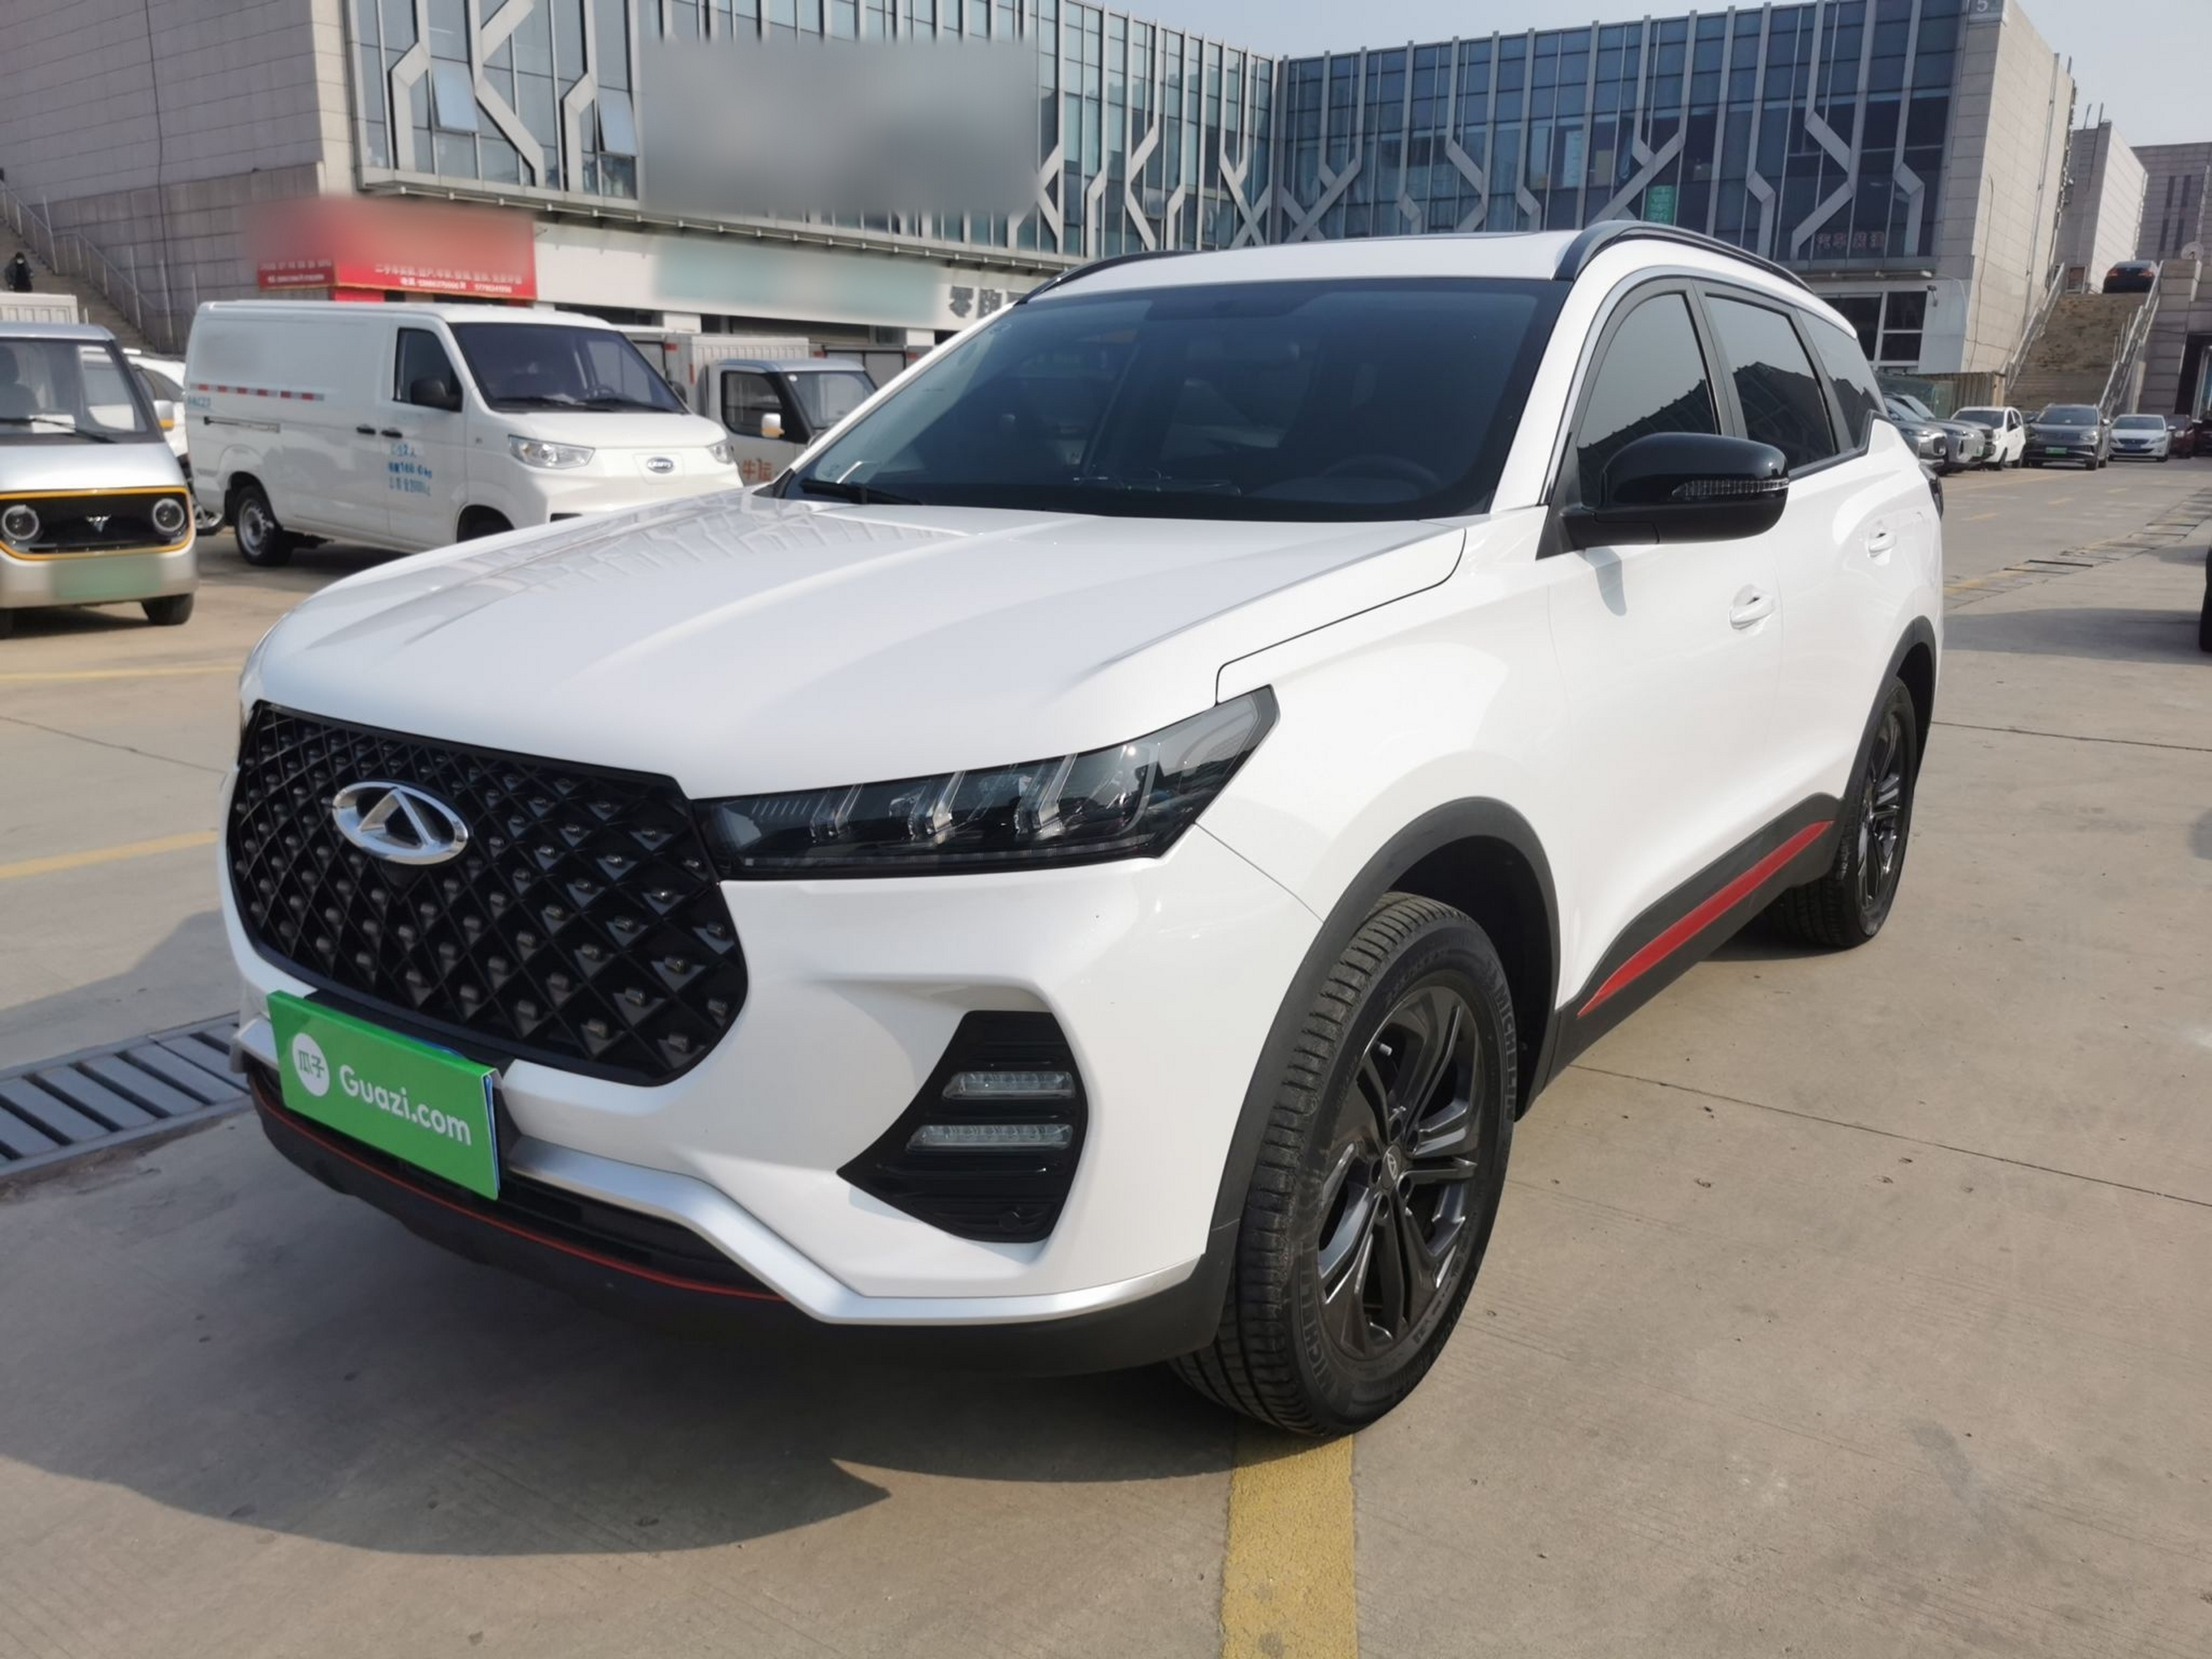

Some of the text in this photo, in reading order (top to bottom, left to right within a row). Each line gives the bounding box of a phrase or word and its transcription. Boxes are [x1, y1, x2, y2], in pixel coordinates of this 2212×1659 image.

[1976, 0, 1988, 12] 5
[297, 1048, 325, 1079] 瓜子
[339, 1064, 472, 1146] Guazi.com
